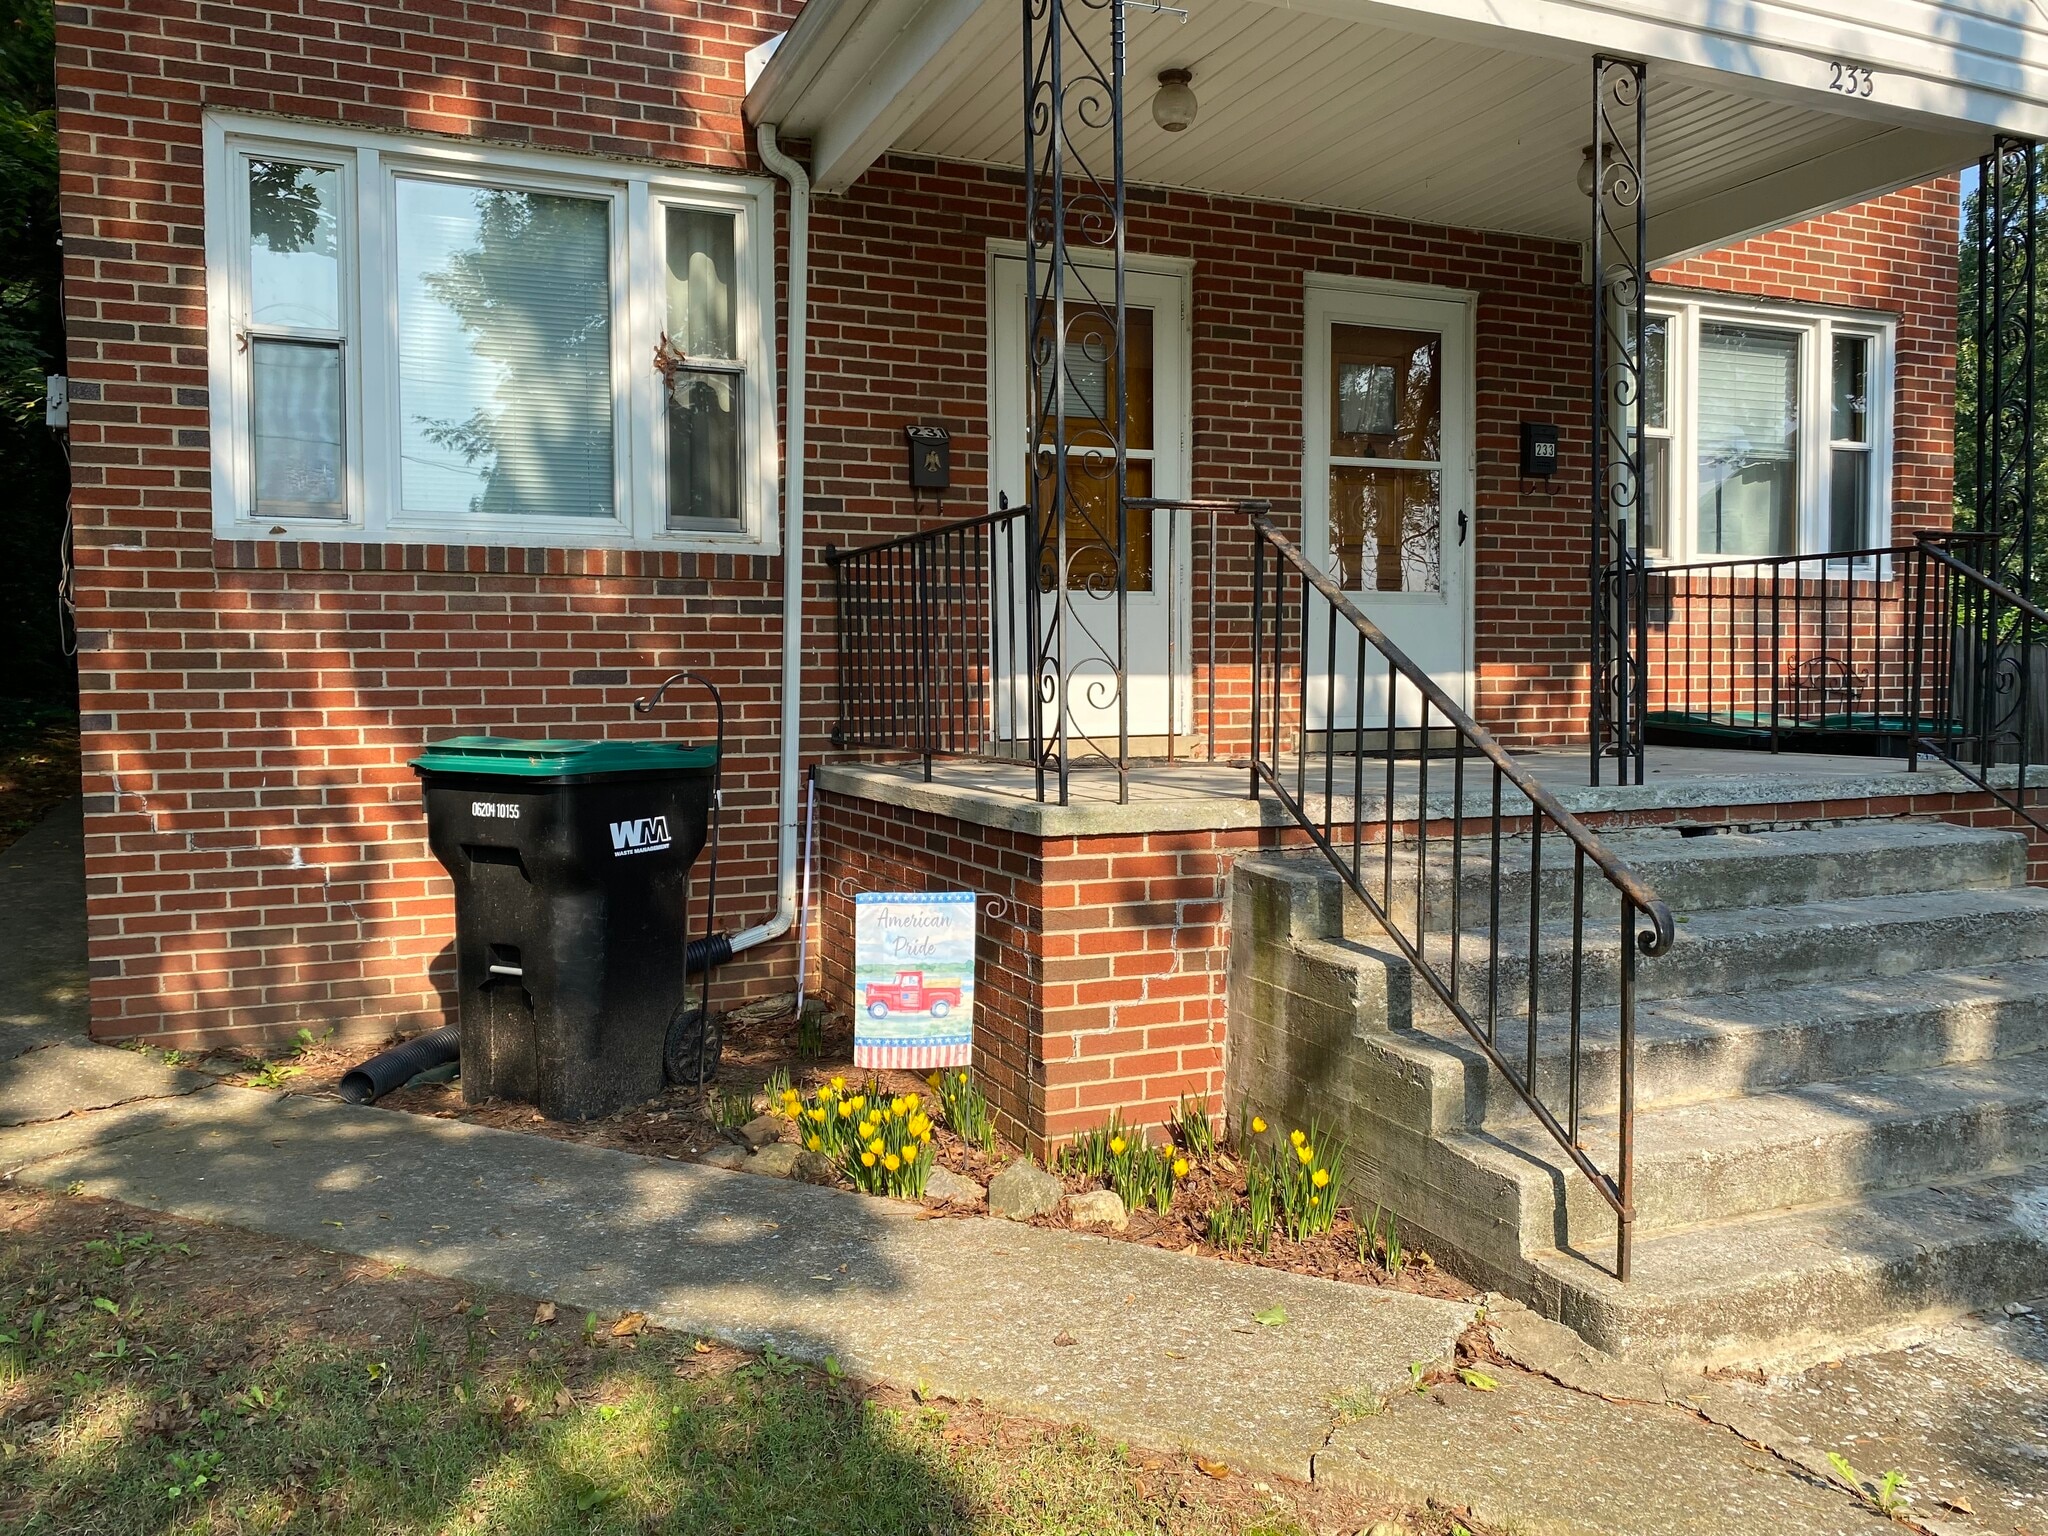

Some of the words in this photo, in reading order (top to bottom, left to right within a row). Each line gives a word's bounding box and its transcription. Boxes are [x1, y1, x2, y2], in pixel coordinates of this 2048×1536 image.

[1829, 61, 1873, 97] 233
[908, 426, 947, 438] 231
[1536, 444, 1554, 456] 233
[609, 815, 671, 850] WM
[614, 849, 634, 857] WASTE
[634, 843, 670, 854] MANAGEMENT
[877, 906, 953, 929] American
[892, 935, 937, 957] Pride
